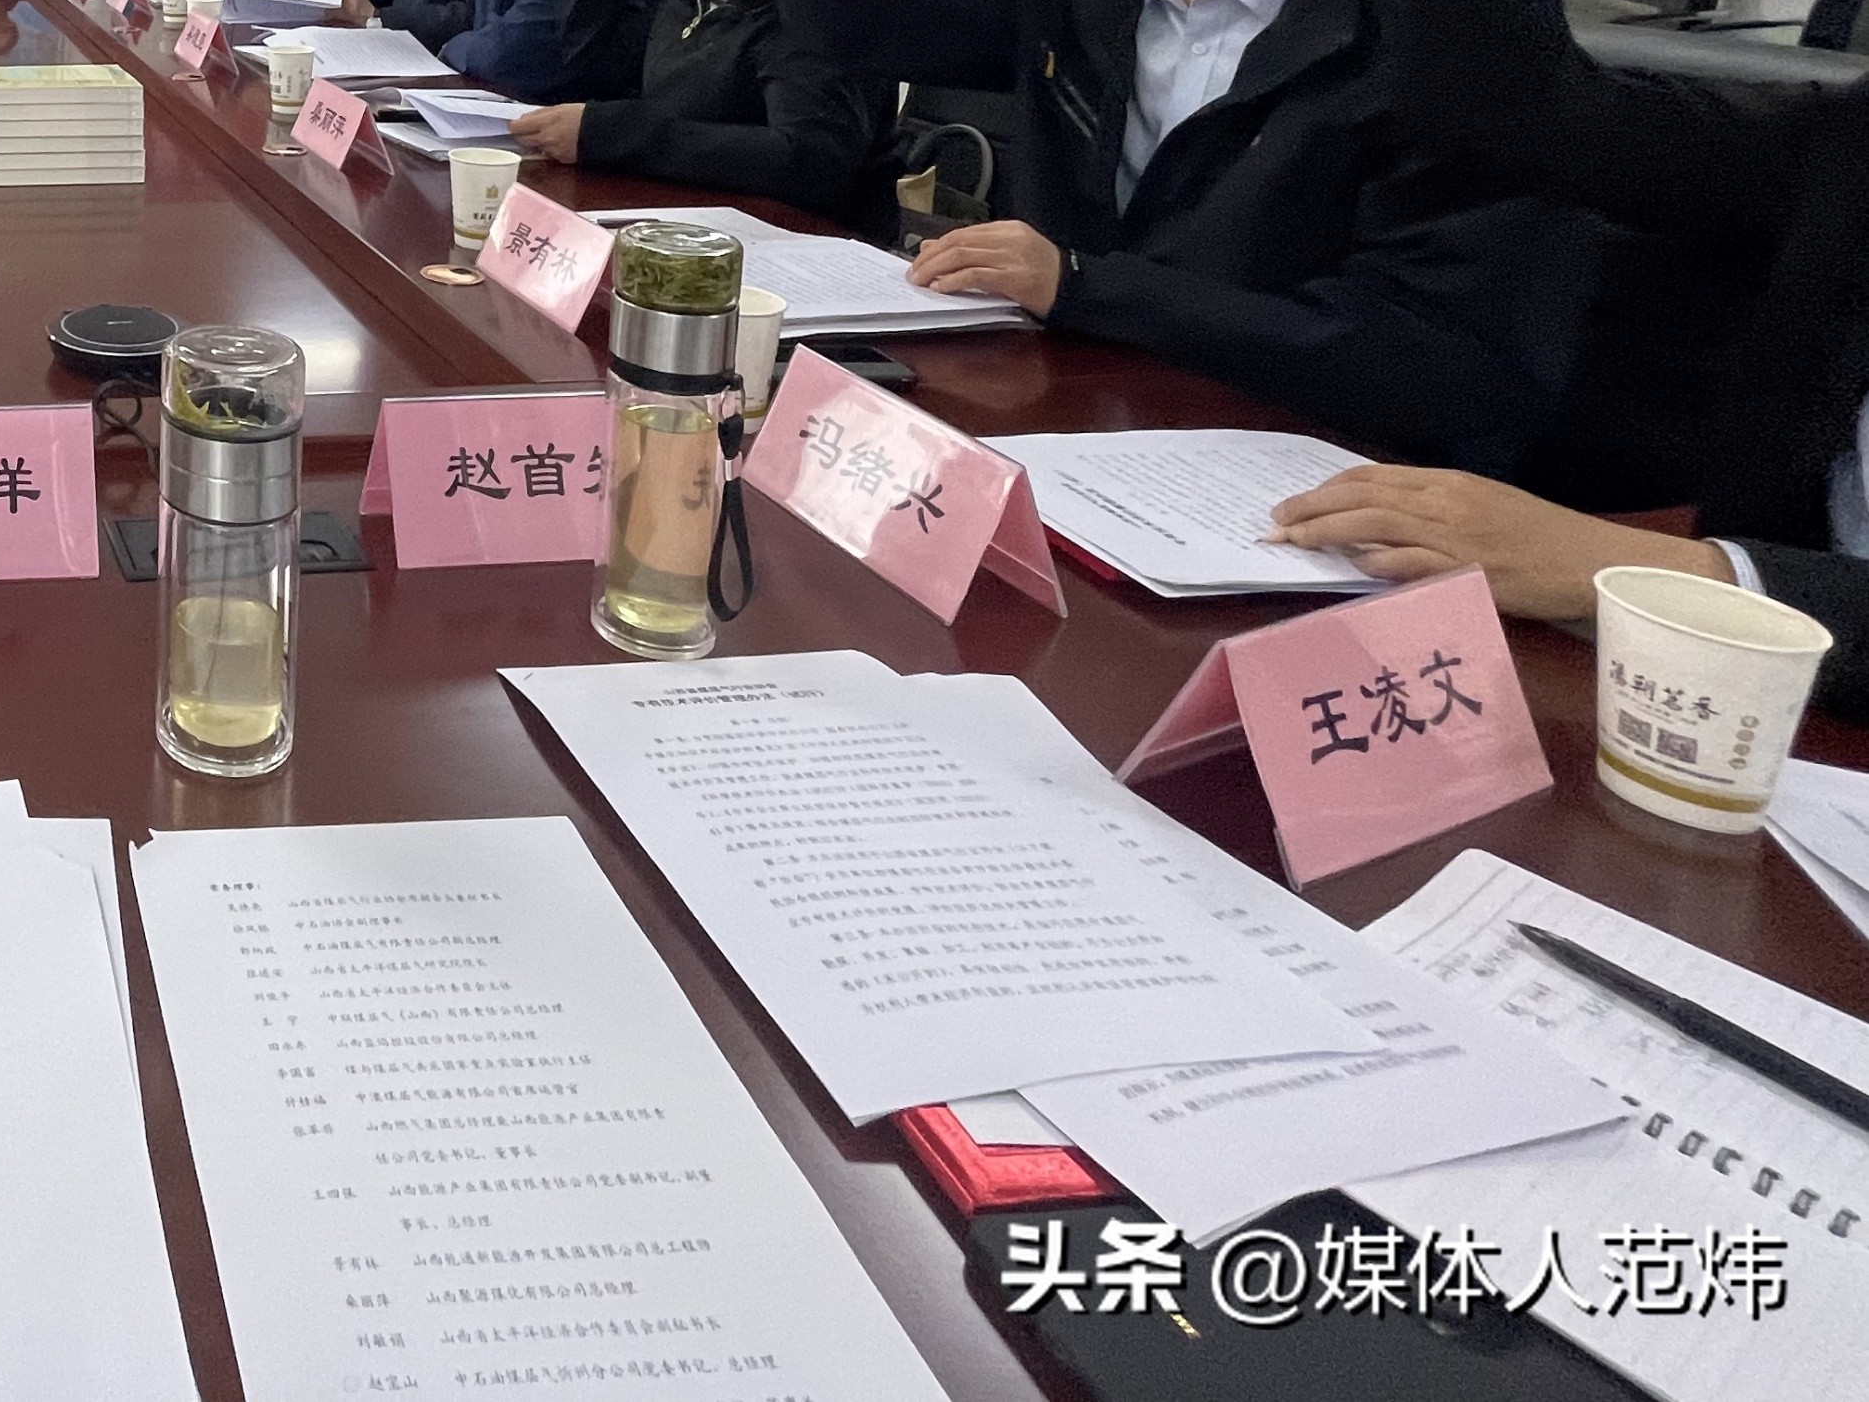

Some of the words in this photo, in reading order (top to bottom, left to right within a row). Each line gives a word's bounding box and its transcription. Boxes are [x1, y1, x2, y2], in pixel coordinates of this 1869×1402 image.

[506, 222, 579, 284] 景有林
[798, 413, 946, 535] 冯绪兴
[1302, 648, 1483, 766] 王凌文
